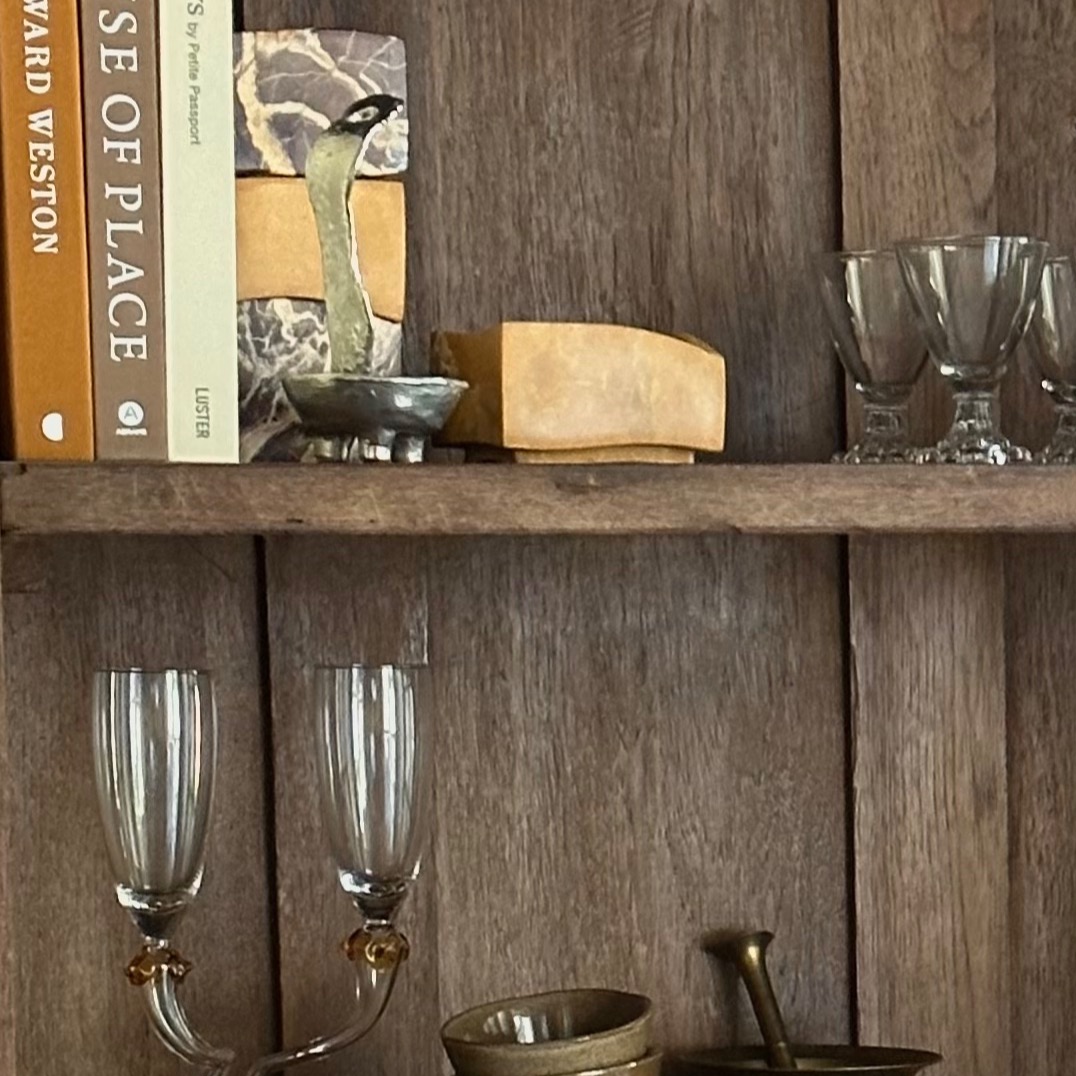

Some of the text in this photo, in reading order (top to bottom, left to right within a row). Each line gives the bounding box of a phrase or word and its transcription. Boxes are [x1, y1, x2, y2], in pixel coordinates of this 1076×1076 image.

[186, 22, 199, 39] by
[188, 43, 200, 81] Petite
[187, 85, 201, 145] Passport
[27, 109, 59, 255] WESTON
[98, 0, 148, 362] SE OF PLACE
[195, 387, 210, 439] LUSTER
